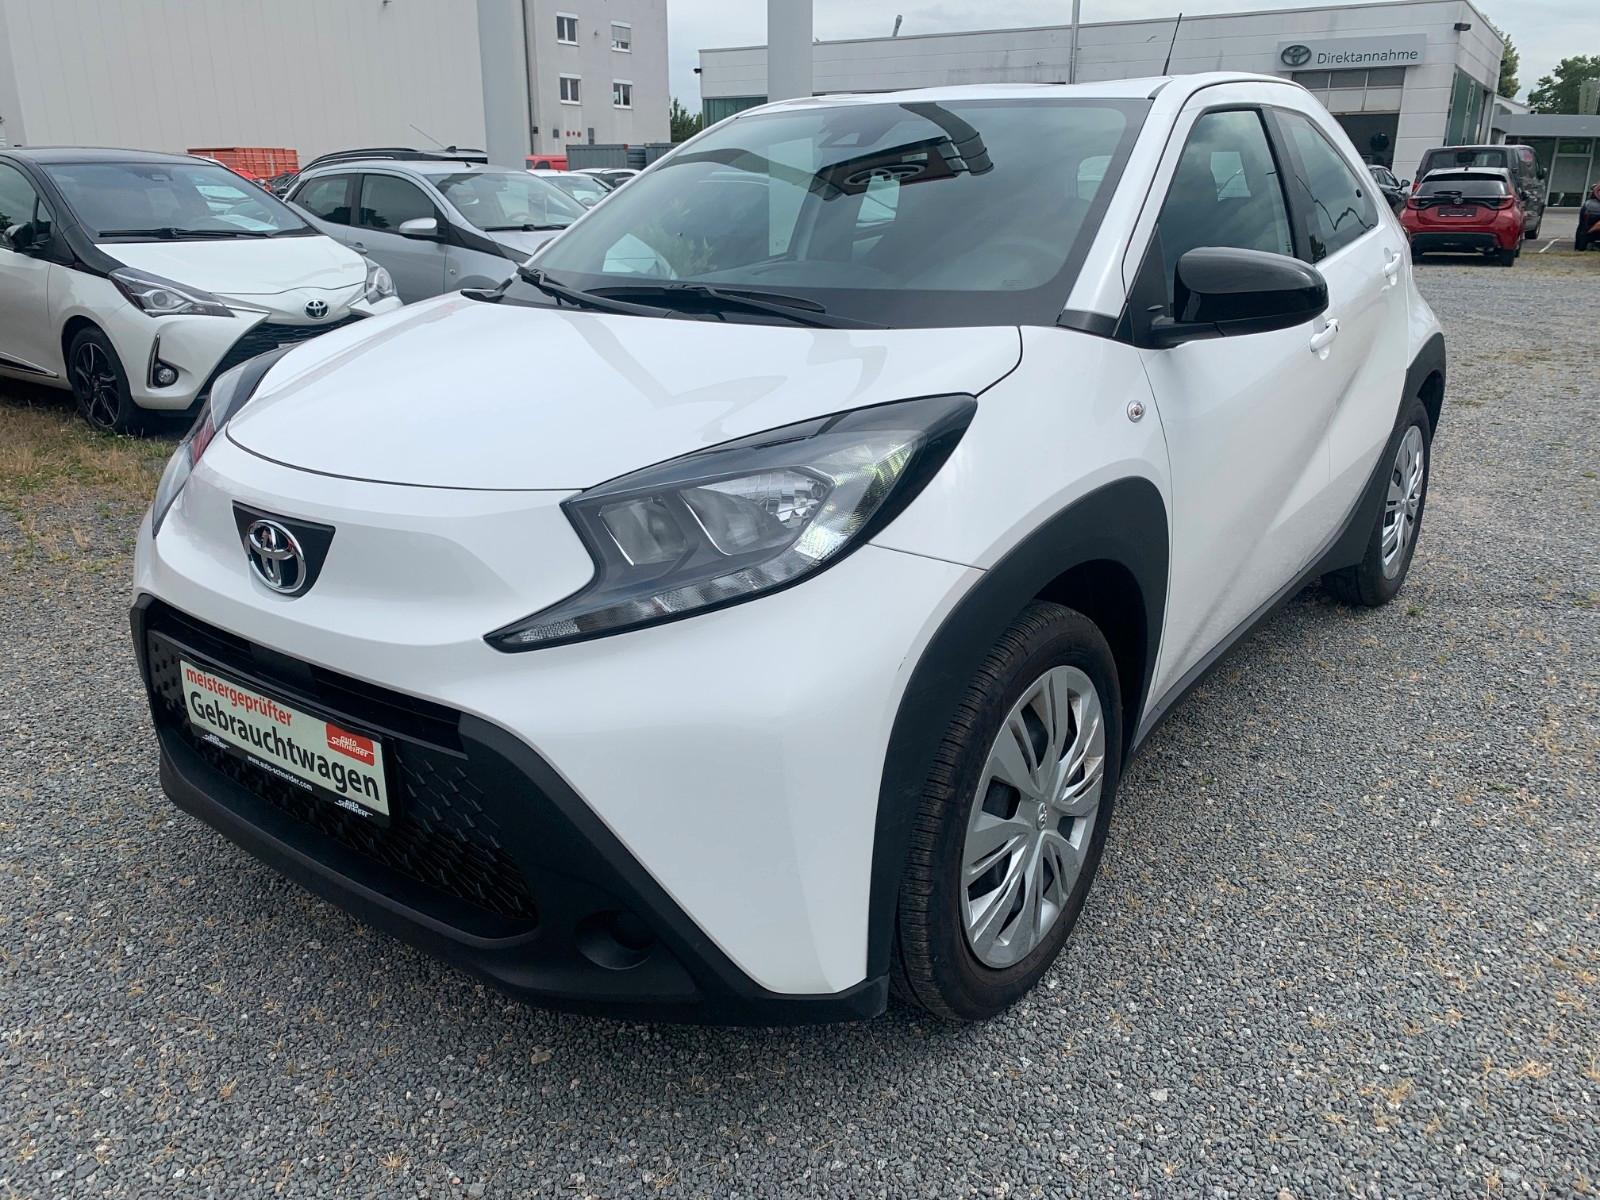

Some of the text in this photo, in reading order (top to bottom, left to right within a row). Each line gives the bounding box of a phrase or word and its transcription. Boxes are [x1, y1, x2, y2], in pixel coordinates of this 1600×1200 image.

[1317, 49, 1418, 64] Direktannahme
[186, 667, 292, 727] meistergeprüfter
[190, 691, 380, 801] Gebrauchtwagen
[340, 735, 357, 746] auto
